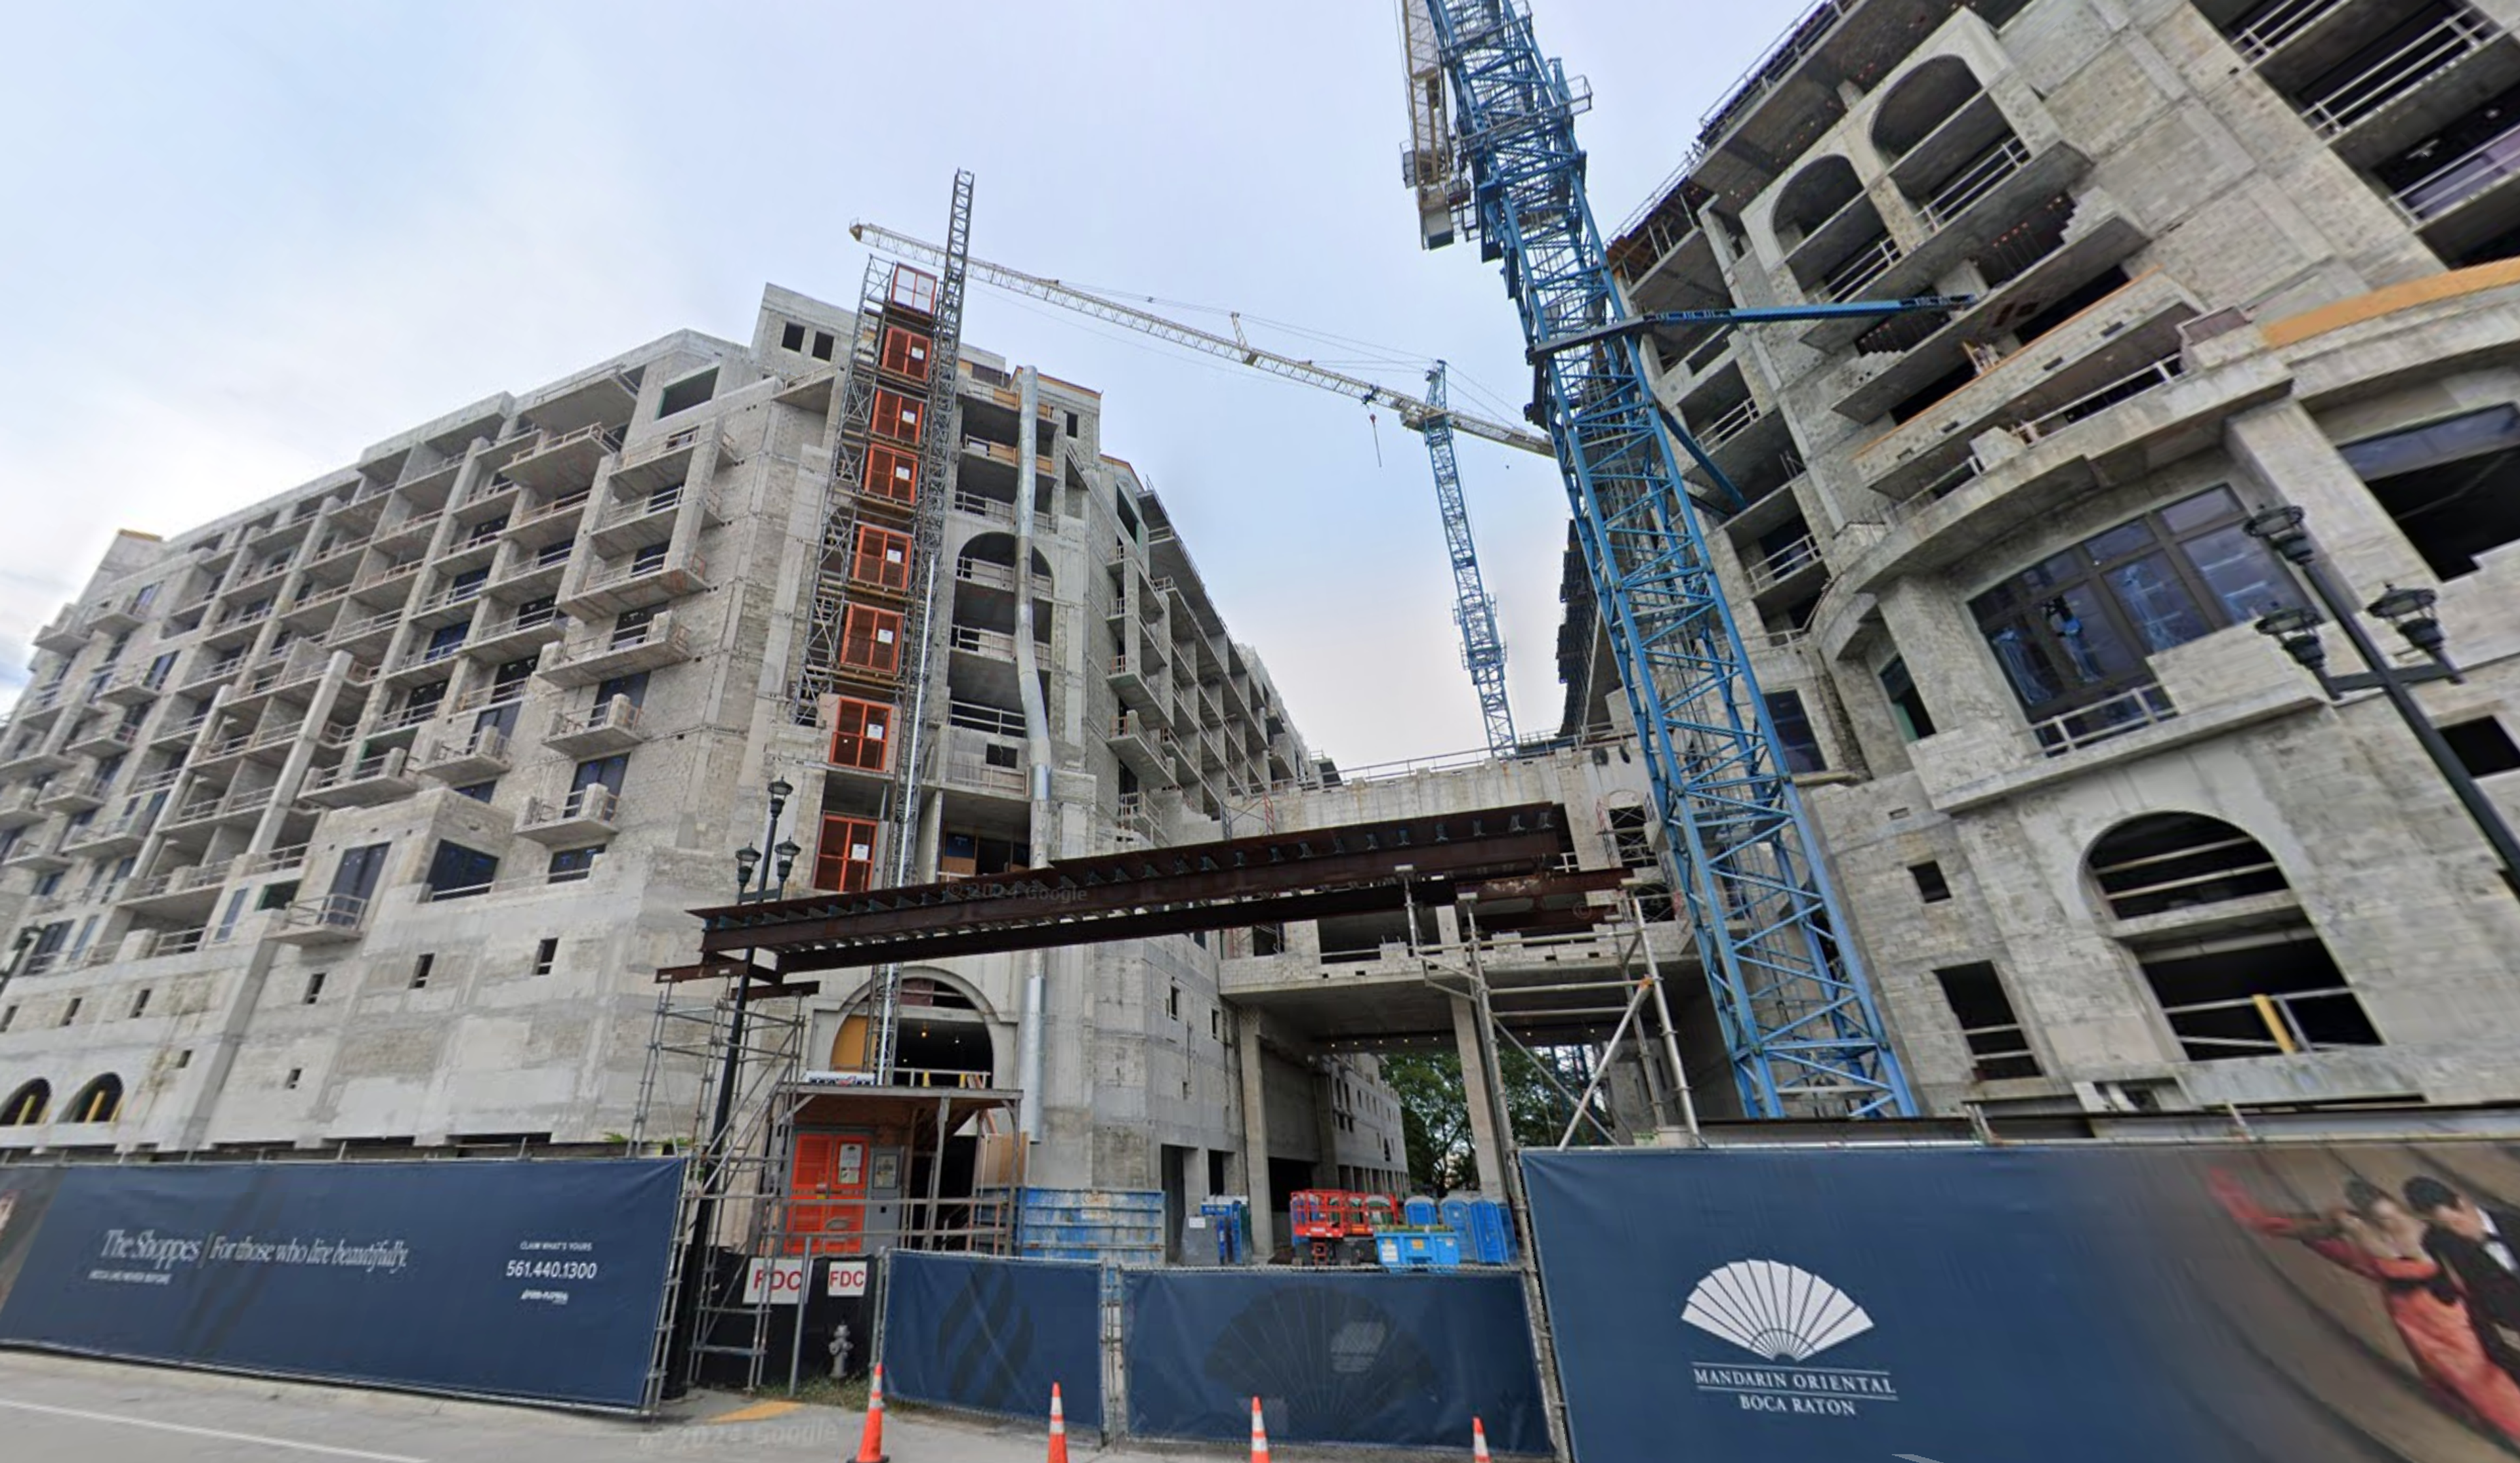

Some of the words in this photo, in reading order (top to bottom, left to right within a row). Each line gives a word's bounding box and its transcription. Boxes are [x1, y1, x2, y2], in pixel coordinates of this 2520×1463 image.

[100, 1229, 133, 1258] The
[131, 1229, 201, 1270] Shoppes
[209, 1235, 236, 1259] For
[234, 1236, 275, 1263] those
[274, 1238, 307, 1263] who
[505, 1259, 598, 1279] 561.440.1300
[753, 1269, 802, 1290] FDC
[828, 1270, 865, 1287] FDC
[1694, 1368, 1787, 1388] MANDARIN
[1792, 1373, 1897, 1395] ORIENTAL
[1739, 1394, 1788, 1412] BOCA
[1791, 1397, 1857, 1416] RATON
